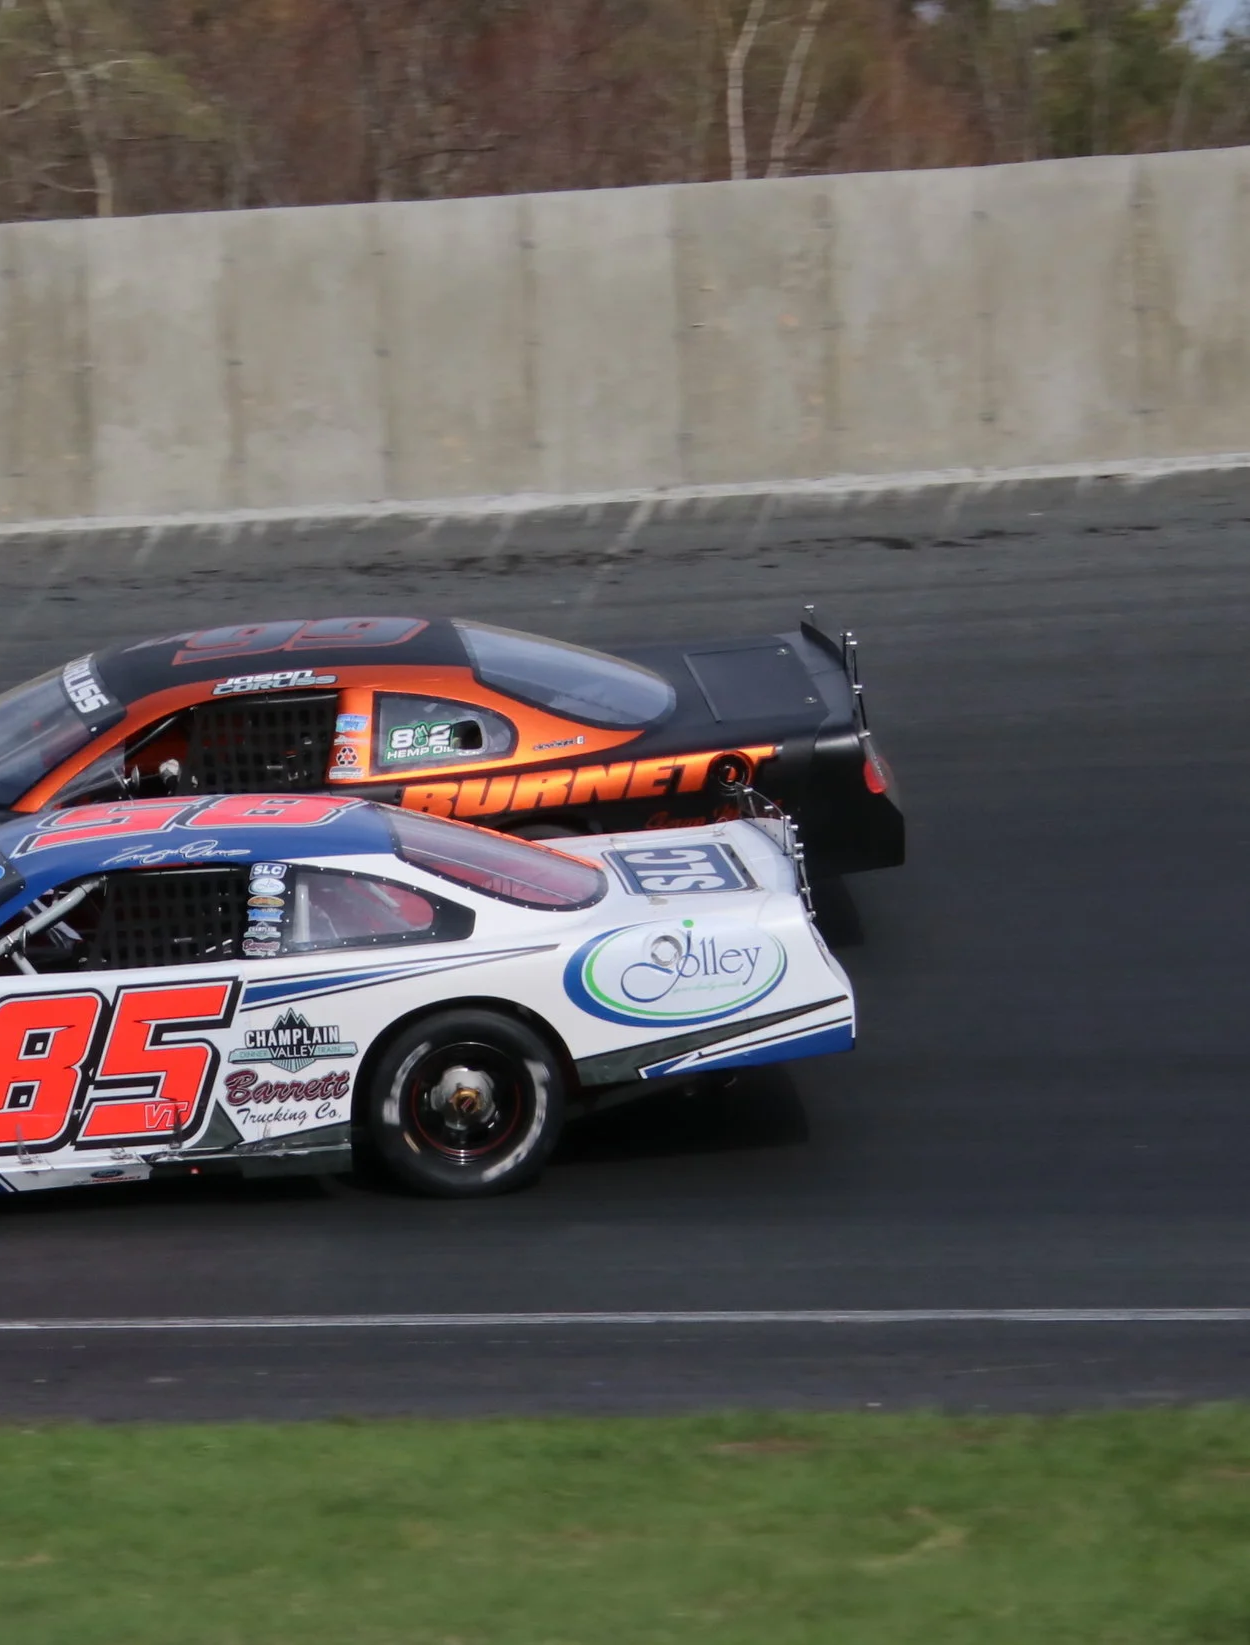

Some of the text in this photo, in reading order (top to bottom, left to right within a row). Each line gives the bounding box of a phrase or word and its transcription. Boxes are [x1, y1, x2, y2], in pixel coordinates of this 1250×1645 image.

[62, 653, 110, 713] RLISS
[387, 744, 455, 760] HEMP OIL
[253, 865, 283, 875] SLC
[624, 849, 726, 891] SLC
[245, 1025, 340, 1048] CHAMPLAIN
[239, 1050, 268, 1059] DINNER
[269, 1045, 317, 1058] VALLEY
[316, 1045, 342, 1054] TRAIN
[224, 1069, 350, 1107] Barrett
[145, 1101, 189, 1129] VT
[236, 1107, 309, 1126] Trucking
